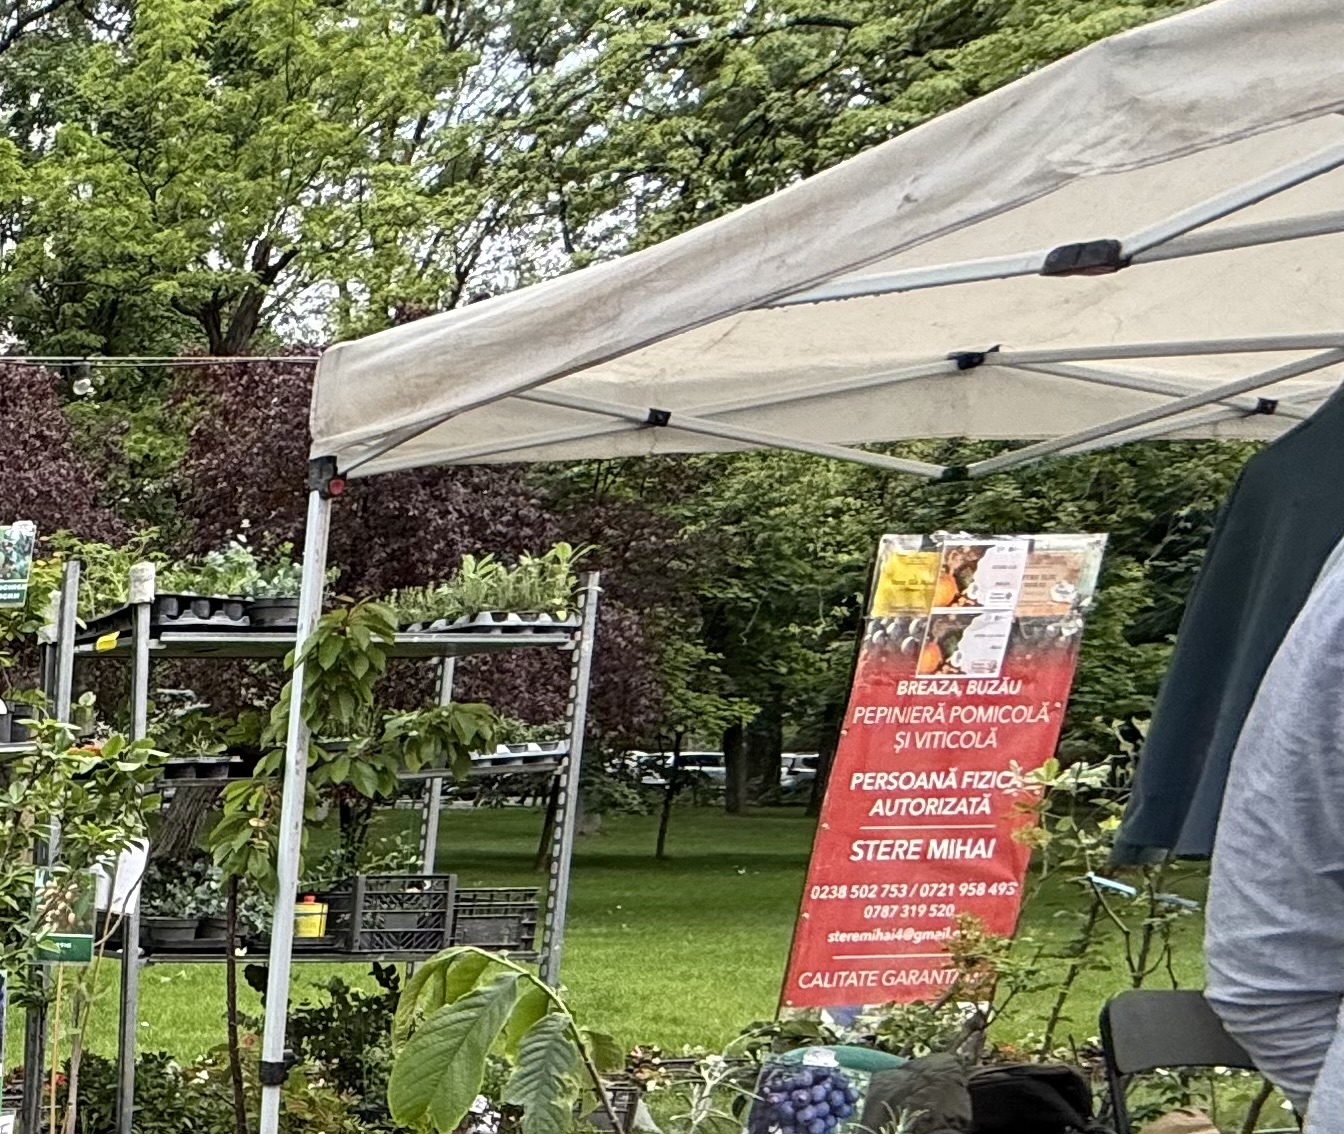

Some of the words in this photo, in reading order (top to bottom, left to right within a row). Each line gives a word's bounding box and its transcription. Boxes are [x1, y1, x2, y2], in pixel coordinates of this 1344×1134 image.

[896, 679, 962, 697] BREAZA,
[965, 676, 1022, 695] BUZĂU
[852, 702, 946, 725] PEPINIERĂ
[948, 701, 1050, 724] POMICOLĂ
[914, 727, 997, 749] VITICOLĂ
[850, 768, 958, 791] PERSOANĂ
[868, 793, 993, 817] AUTORIZATĂ
[849, 838, 924, 862] STERE
[926, 837, 997, 860] MIHAI
[849, 884, 878, 900] 502
[879, 883, 909, 899] 753
[919, 882, 955, 898] 0721
[958, 882, 987, 898] 958
[863, 905, 899, 919] 0787
[900, 904, 927, 918] 319
[798, 970, 879, 989] CALITATE
